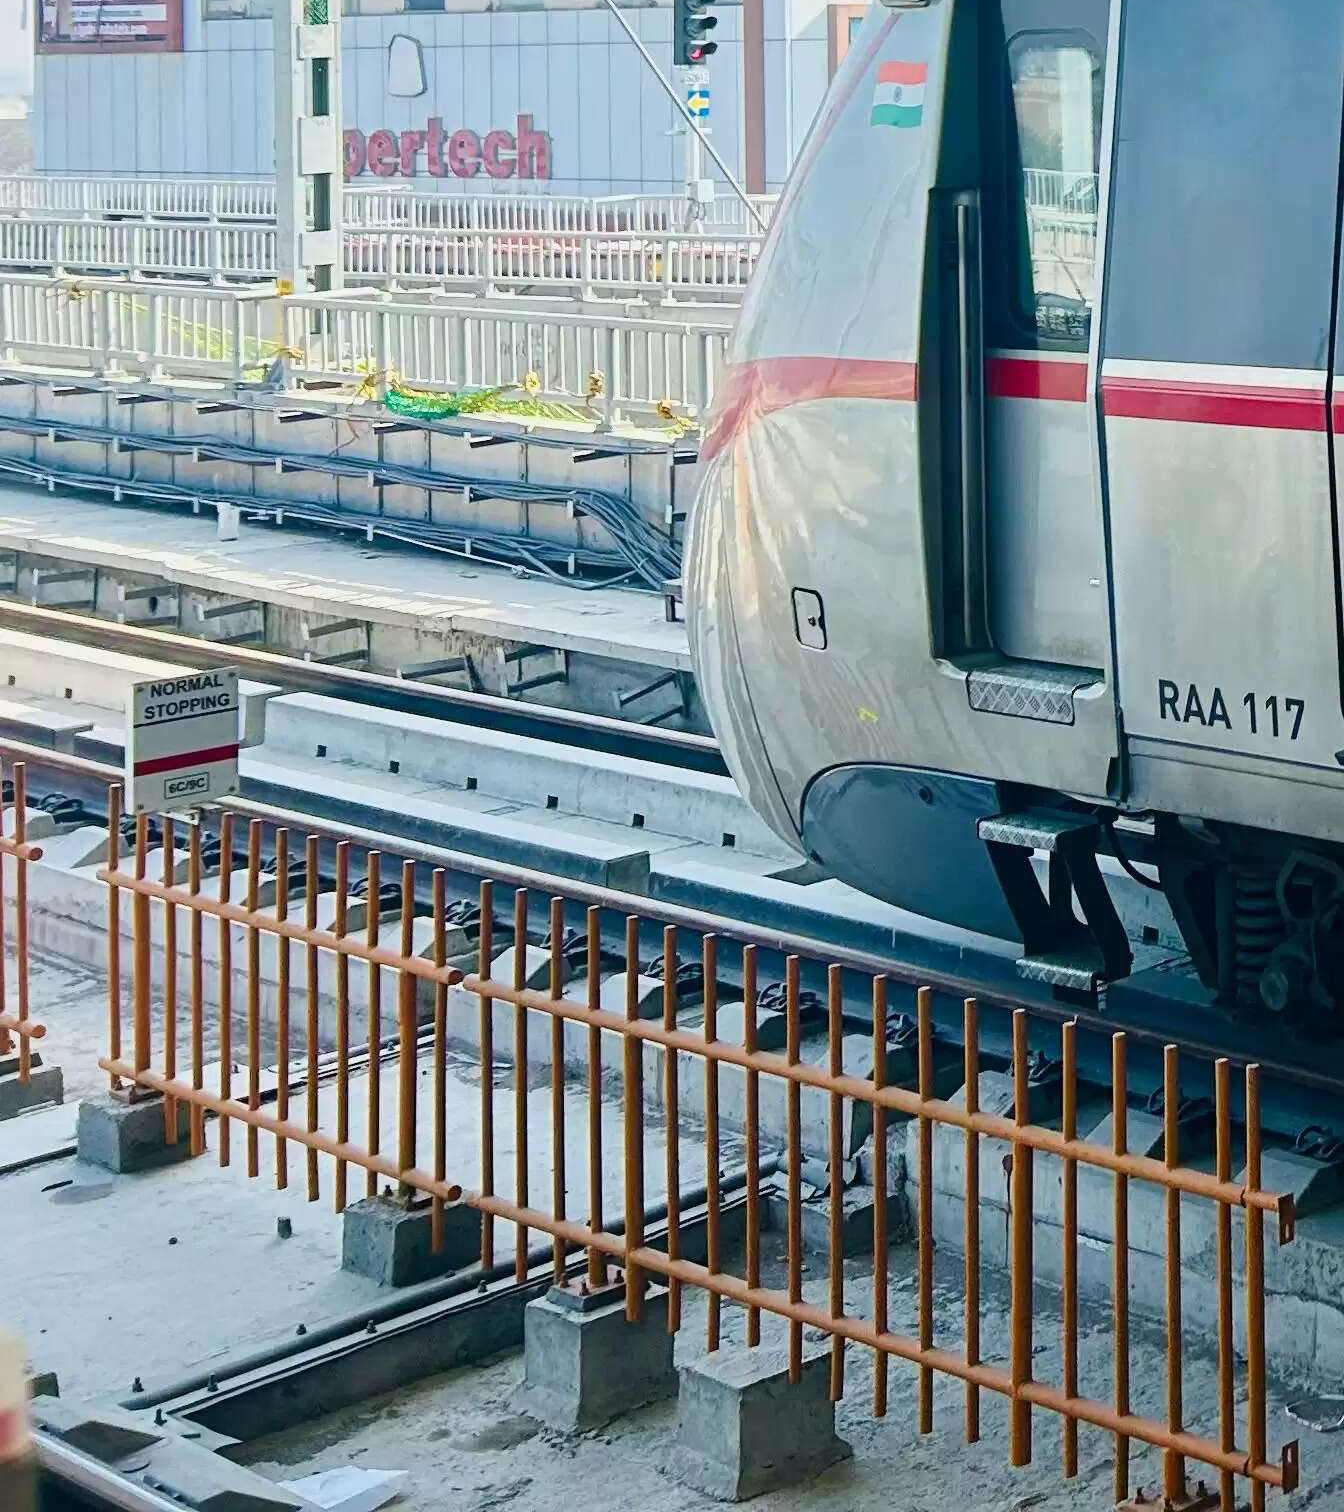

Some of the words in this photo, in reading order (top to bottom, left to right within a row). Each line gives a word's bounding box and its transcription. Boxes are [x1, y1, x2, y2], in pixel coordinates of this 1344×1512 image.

[149, 674, 225, 698] NORMAL
[144, 692, 231, 720] STOPPING
[1158, 679, 1233, 730] RAA
[1243, 692, 1305, 740] 117
